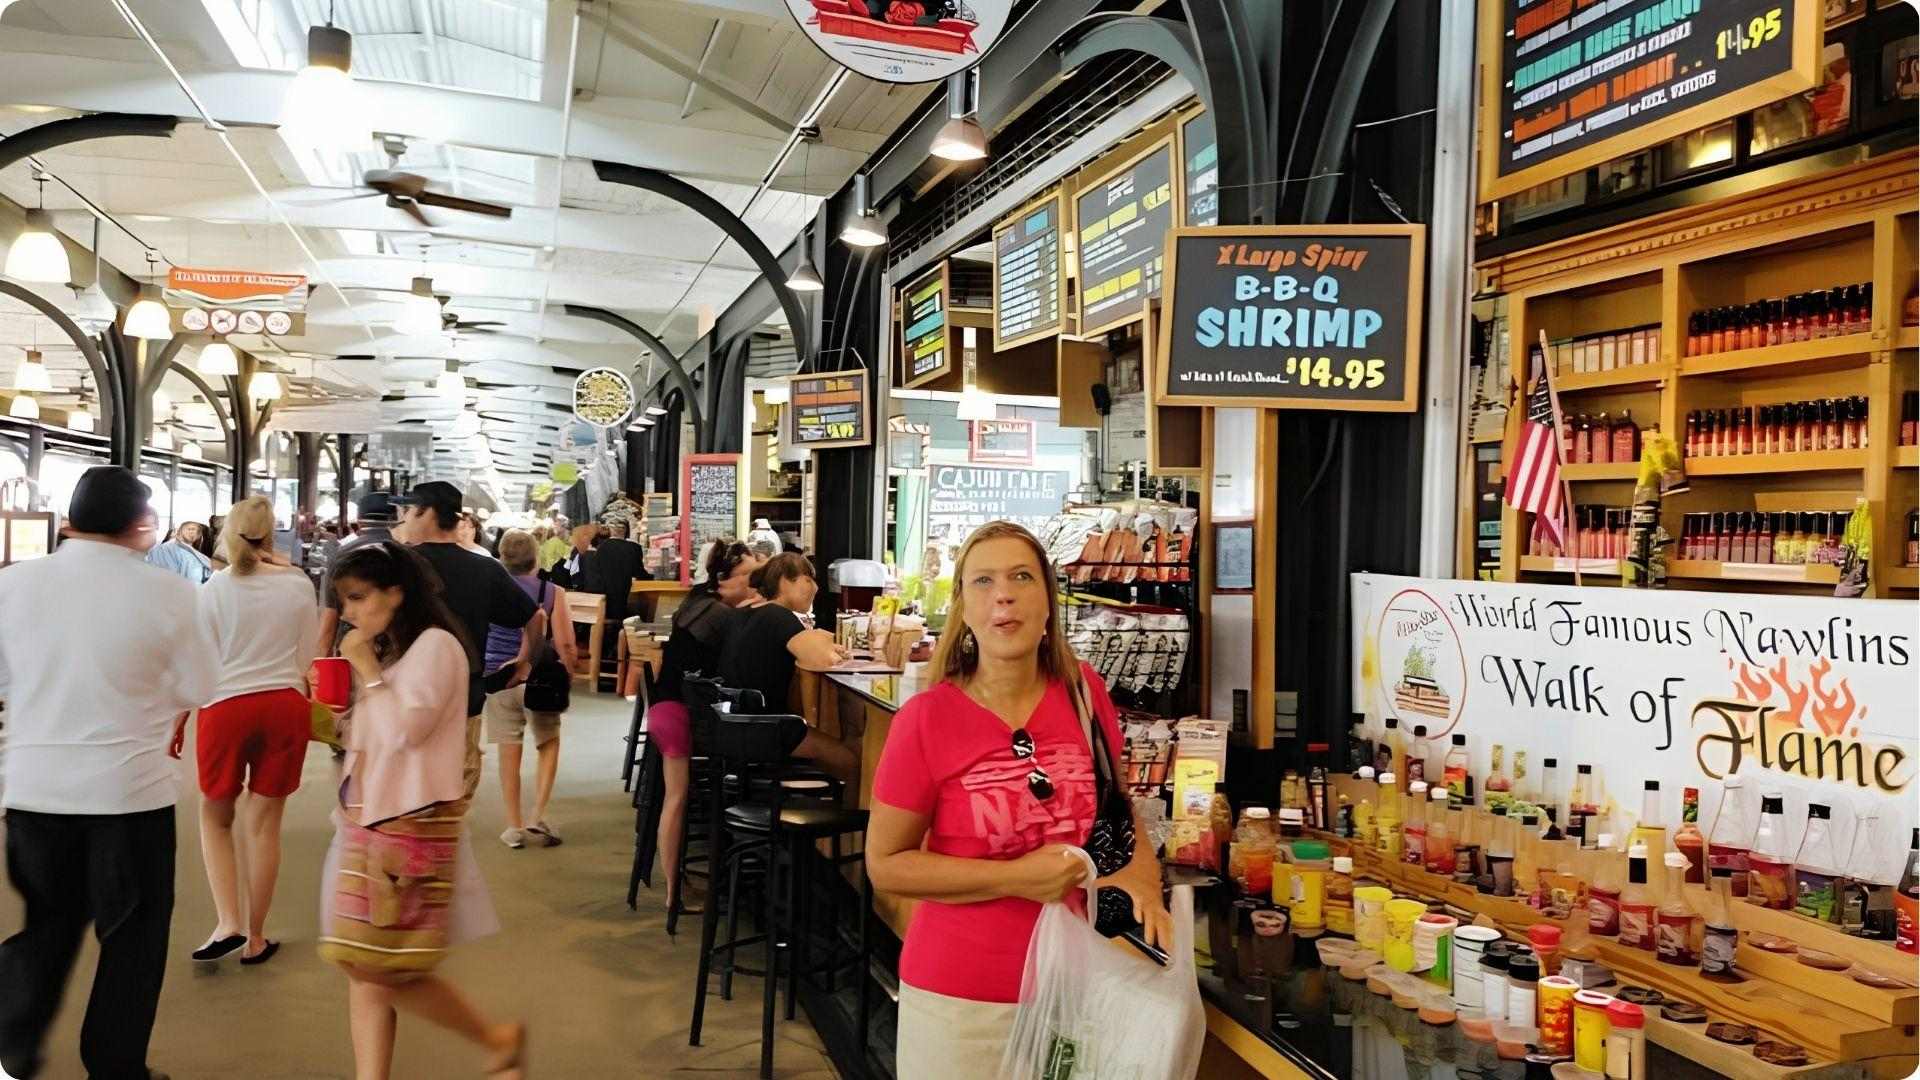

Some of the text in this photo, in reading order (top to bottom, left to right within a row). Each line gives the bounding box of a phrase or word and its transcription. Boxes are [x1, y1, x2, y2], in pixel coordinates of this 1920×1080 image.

[1217, 244, 1235, 265] X
[1235, 275, 1339, 303] B-B-Q
[1195, 306, 1383, 349] SHRIMP
[1286, 357, 1386, 389] $14.95
[1450, 594, 1537, 631] World
[1545, 601, 1692, 646] Famous
[1704, 609, 1909, 667] Nawlins
[1481, 655, 1686, 750] Walk of
[1691, 701, 1912, 792] Flame
